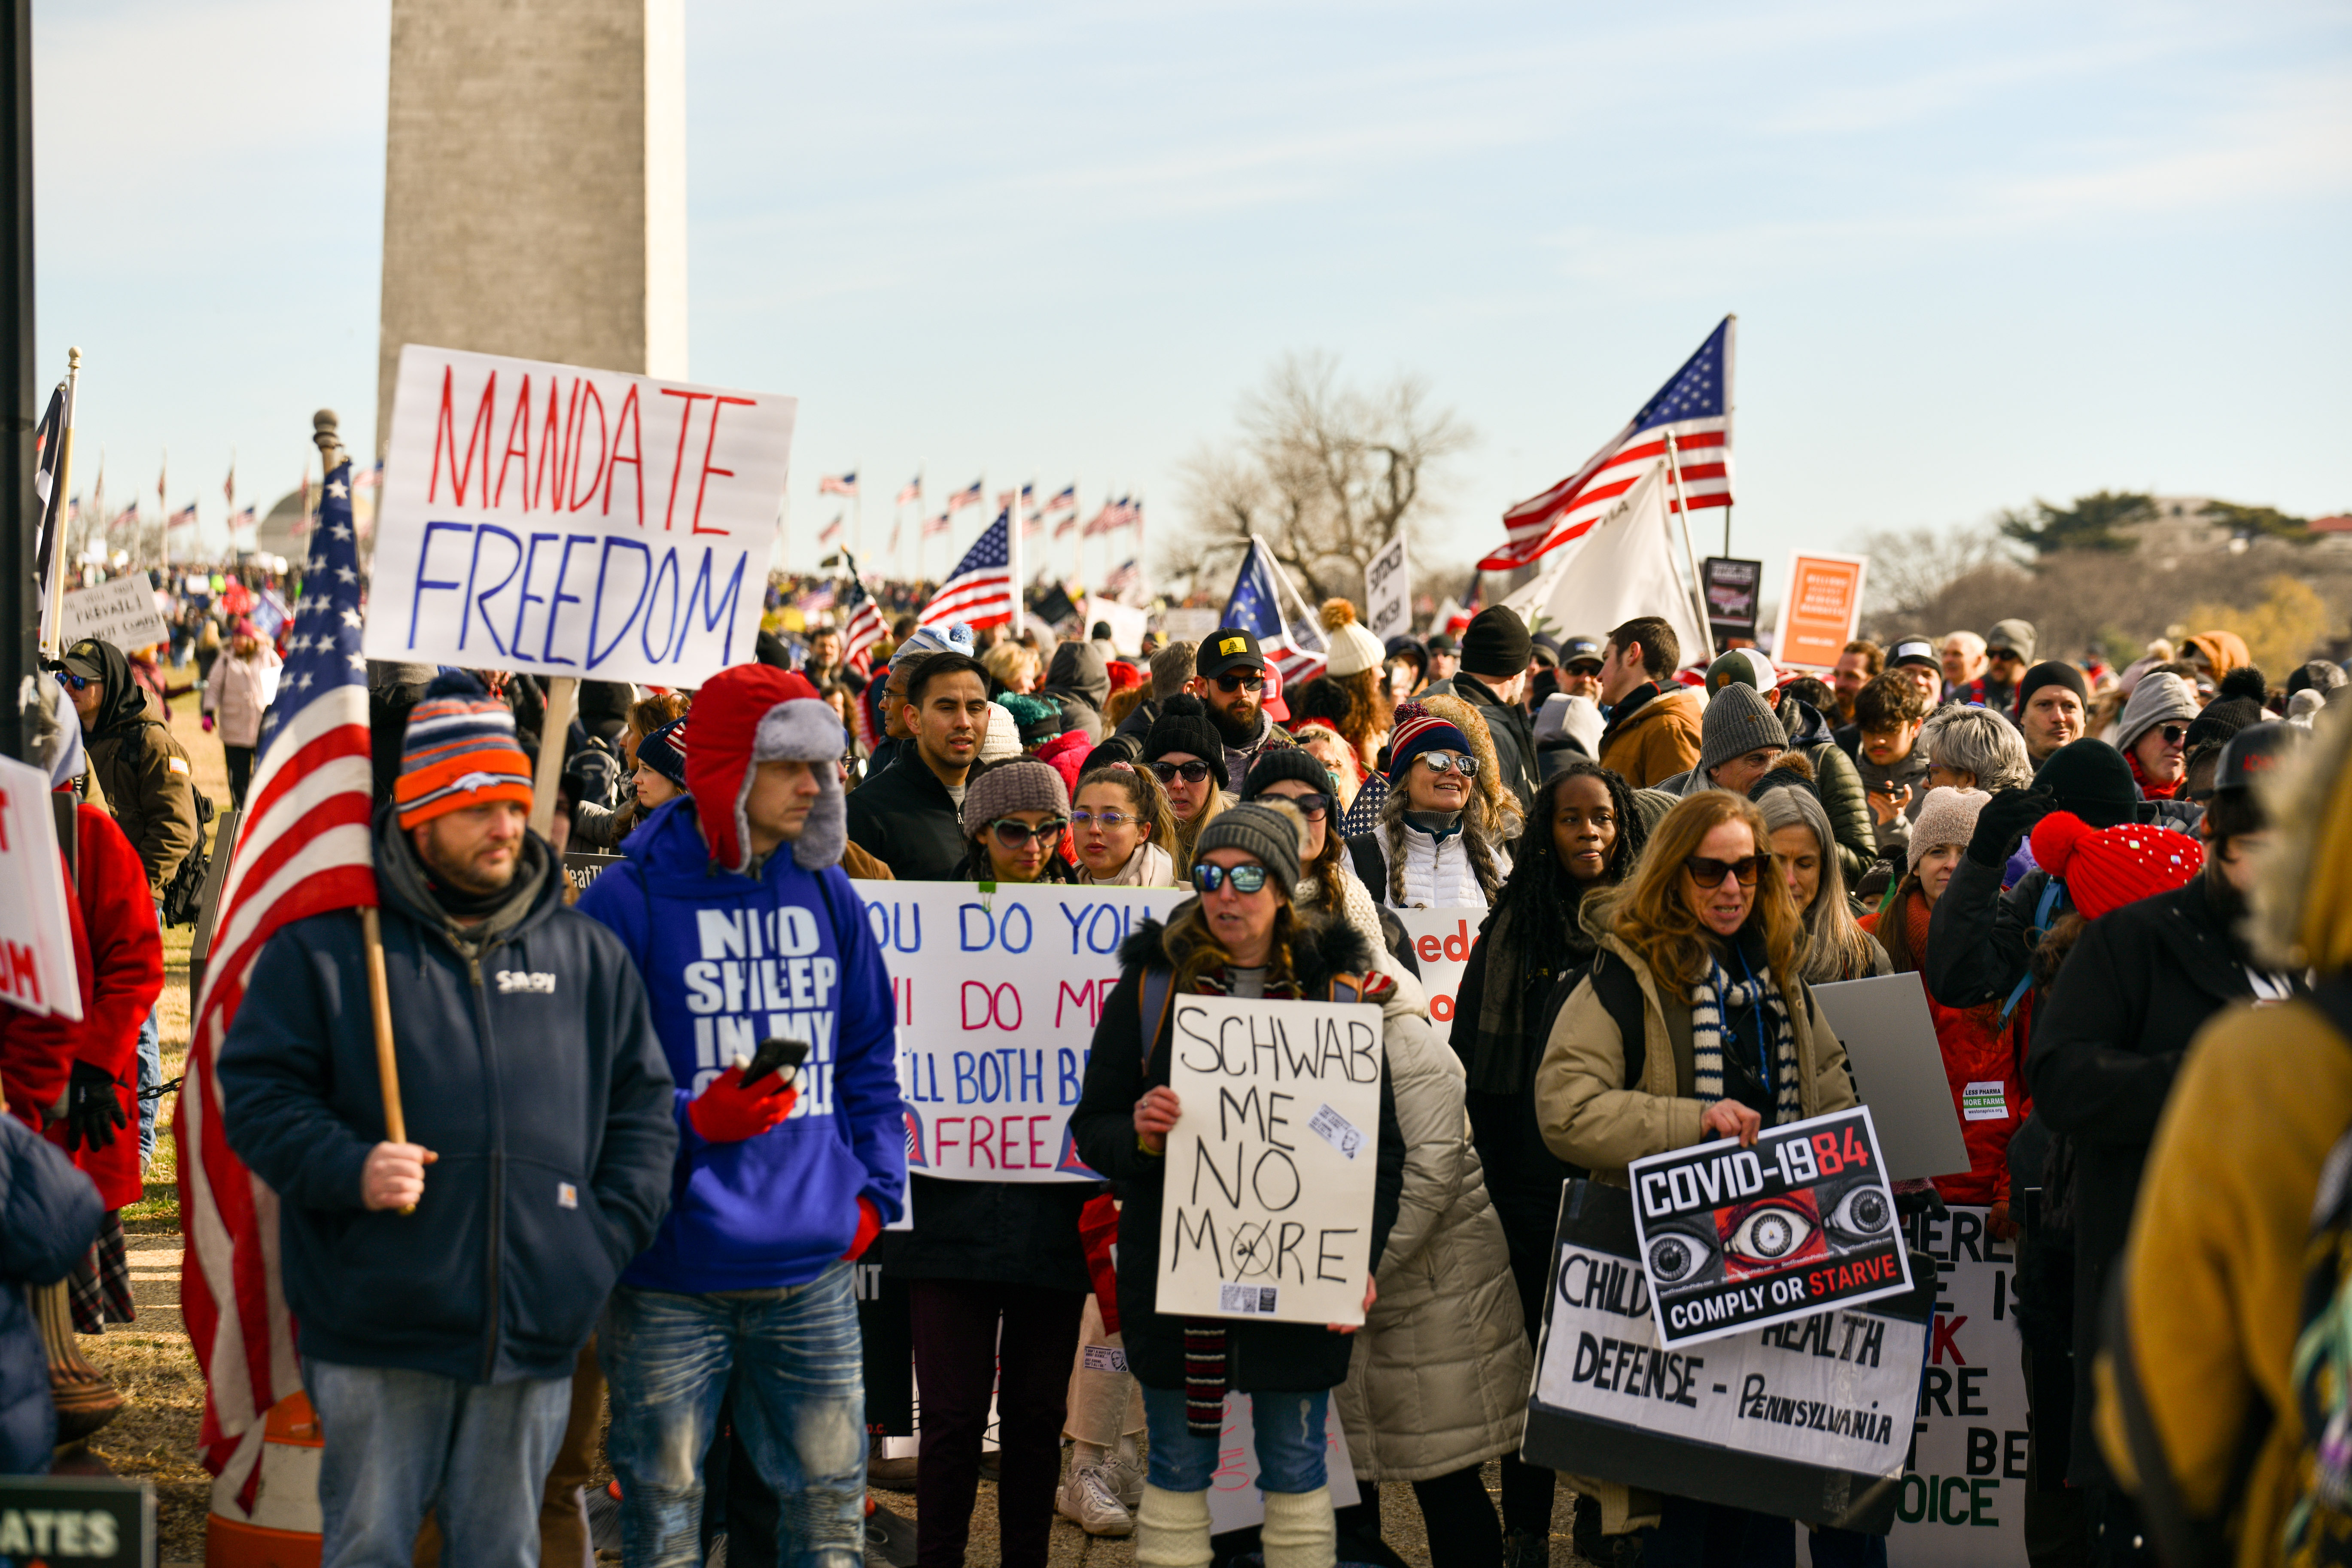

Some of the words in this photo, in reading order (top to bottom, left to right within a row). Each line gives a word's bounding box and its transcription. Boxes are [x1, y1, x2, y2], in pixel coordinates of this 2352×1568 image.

[429, 364, 757, 535] MANDATE
[408, 521, 748, 671] FREEDOM
[959, 902, 1032, 954] DO
[961, 980, 1022, 1031] DO
[694, 1016, 757, 1068] IN
[954, 1048, 1044, 1104] BOTH
[1058, 1047, 1091, 1105] B
[1178, 1006, 1378, 1083] SCHWAB
[936, 1116, 1052, 1169] FREE
[1220, 1086, 1295, 1151] ME
[1192, 1136, 1300, 1211] NO
[1640, 1126, 1868, 1218] COVID-1984
[1171, 1206, 1359, 1285] MORE
[1670, 1285, 1764, 1330] COMPLY
[1771, 1277, 1806, 1306] OR
[1808, 1254, 1897, 1296] STARVE
[1572, 1331, 1704, 1408] DEFENSE
[1966, 1427, 2029, 1479] BE
[1896, 1474, 2000, 1527] OICE
